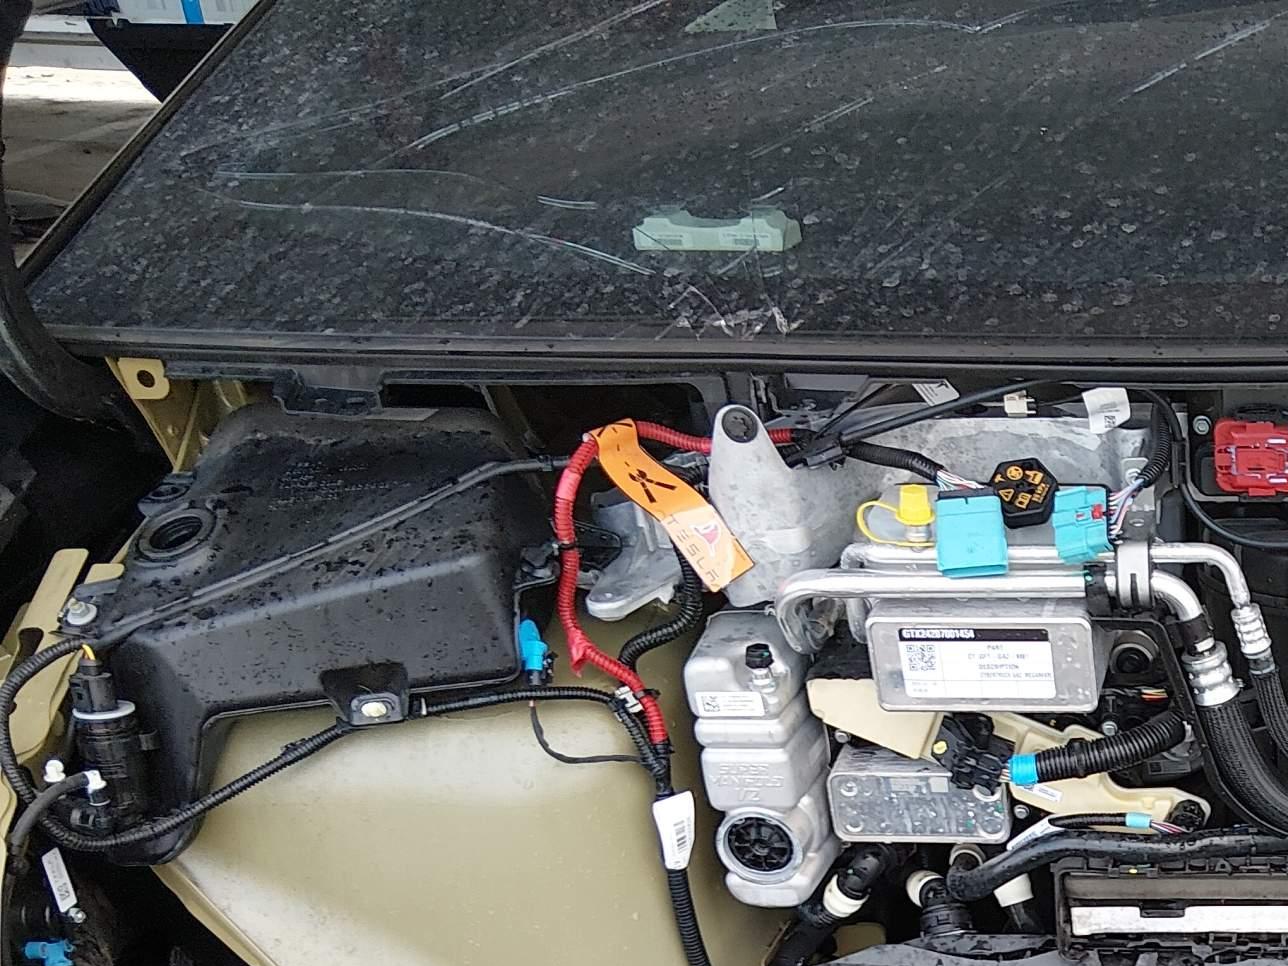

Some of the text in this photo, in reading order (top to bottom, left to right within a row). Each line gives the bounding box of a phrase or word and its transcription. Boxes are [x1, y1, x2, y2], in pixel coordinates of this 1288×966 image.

[667, 513, 720, 582] TESLA
[720, 763, 769, 775] SUPER
[709, 775, 785, 788] MANIFOLD
